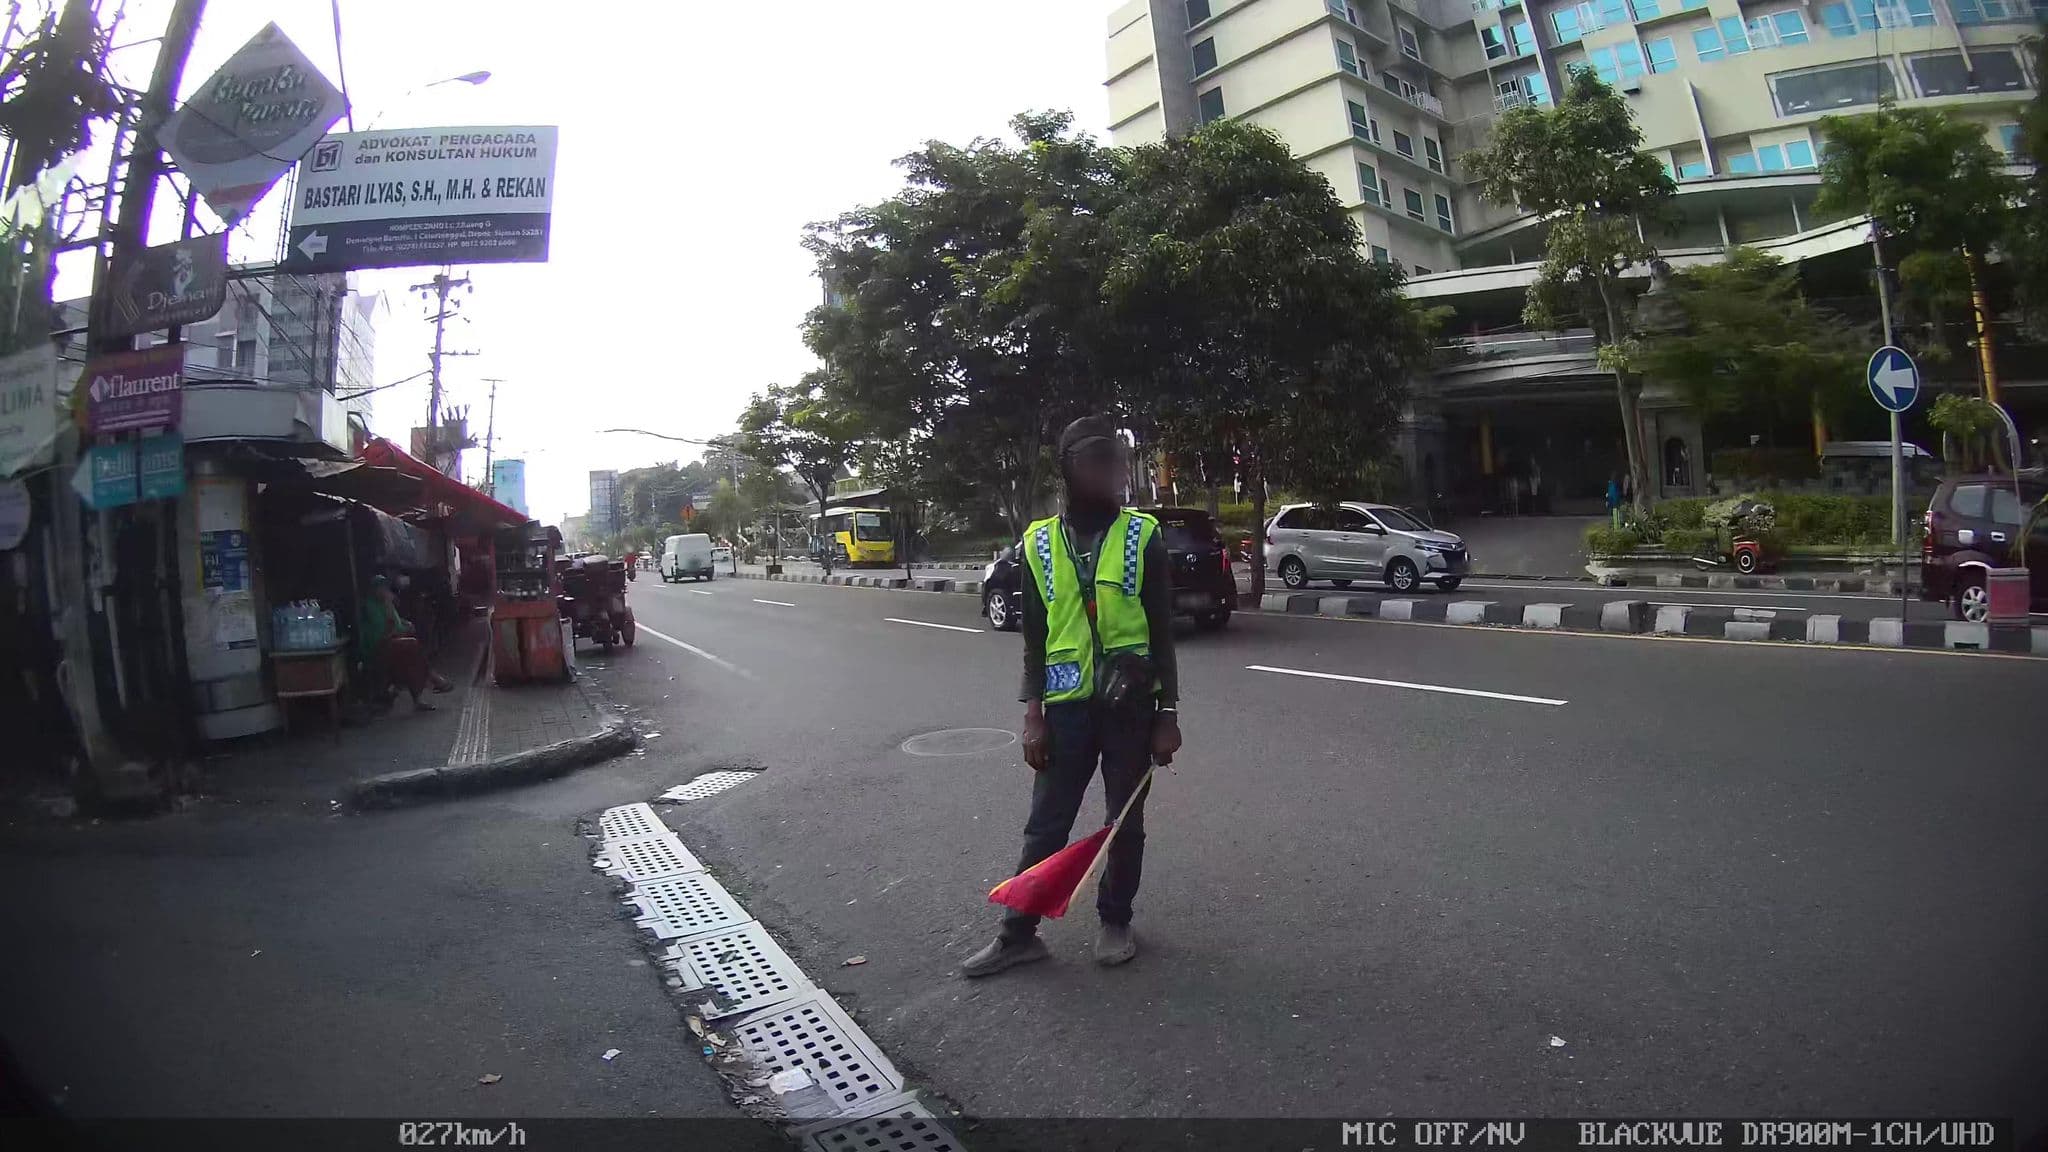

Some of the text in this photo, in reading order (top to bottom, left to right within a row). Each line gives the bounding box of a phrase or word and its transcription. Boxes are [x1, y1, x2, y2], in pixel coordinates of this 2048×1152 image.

[358, 133, 537, 150] ADVOKAT PENGACARA
[354, 147, 538, 165] dan KONSULTAN HUKUM
[303, 176, 546, 210] BASTARI ILYAS, S.H., M.H. & REKAN
